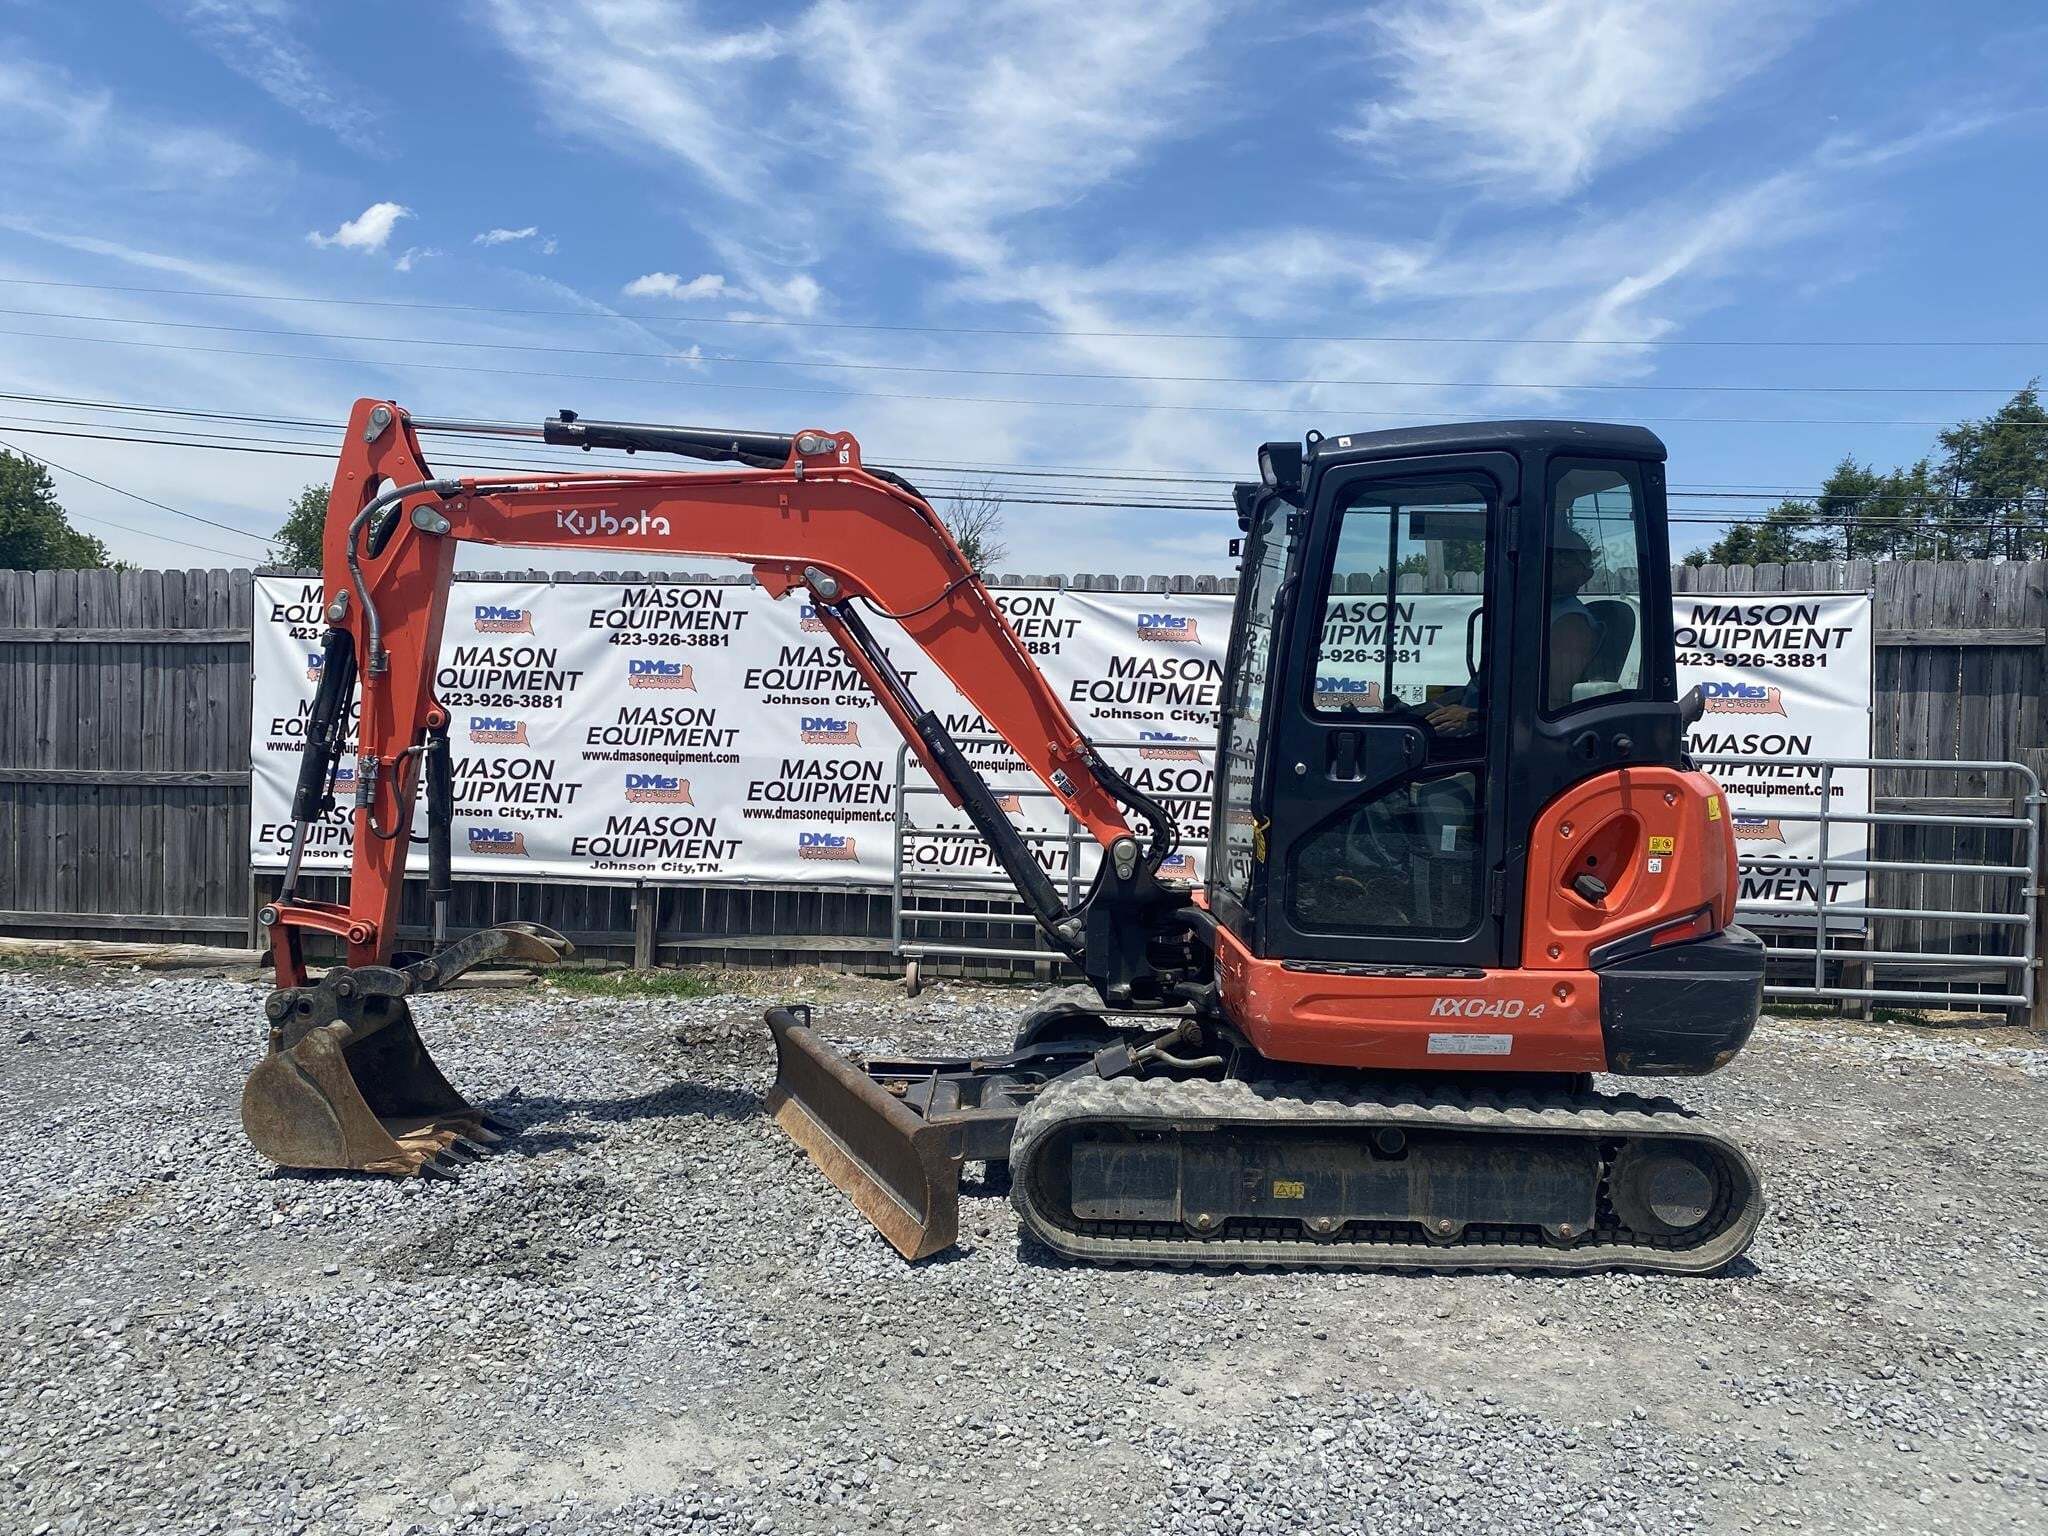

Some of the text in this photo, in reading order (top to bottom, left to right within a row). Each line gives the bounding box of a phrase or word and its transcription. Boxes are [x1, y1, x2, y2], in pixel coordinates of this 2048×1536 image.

[556, 509, 670, 535] Kubota
[621, 588, 722, 608] MASON
[589, 609, 748, 630] EQUIPMENT
[1326, 602, 1415, 622] ASON
[1690, 604, 1820, 626] MASON
[608, 632, 729, 646] 423-926-3881
[1675, 627, 1853, 649] QUIPMENT
[452, 646, 557, 668] MASON
[1675, 652, 1828, 667] 423-926-3881
[437, 668, 584, 691] QUIPMENT
[440, 693, 563, 708] 423-926-3881
[762, 694, 830, 705] Johnson
[618, 707, 716, 726] MASON
[1090, 707, 1164, 720] Johnson
[586, 727, 740, 747] EQUIPMENT
[1690, 733, 1812, 755] MASON
[582, 749, 740, 765] www.dmasonequipment.com
[780, 759, 883, 781] MASON
[498, 807, 562, 820] City,TN.
[606, 816, 716, 837] MASON
[571, 837, 743, 860] EQUIPMENT
[590, 860, 723, 874] Johnson City,TN.
